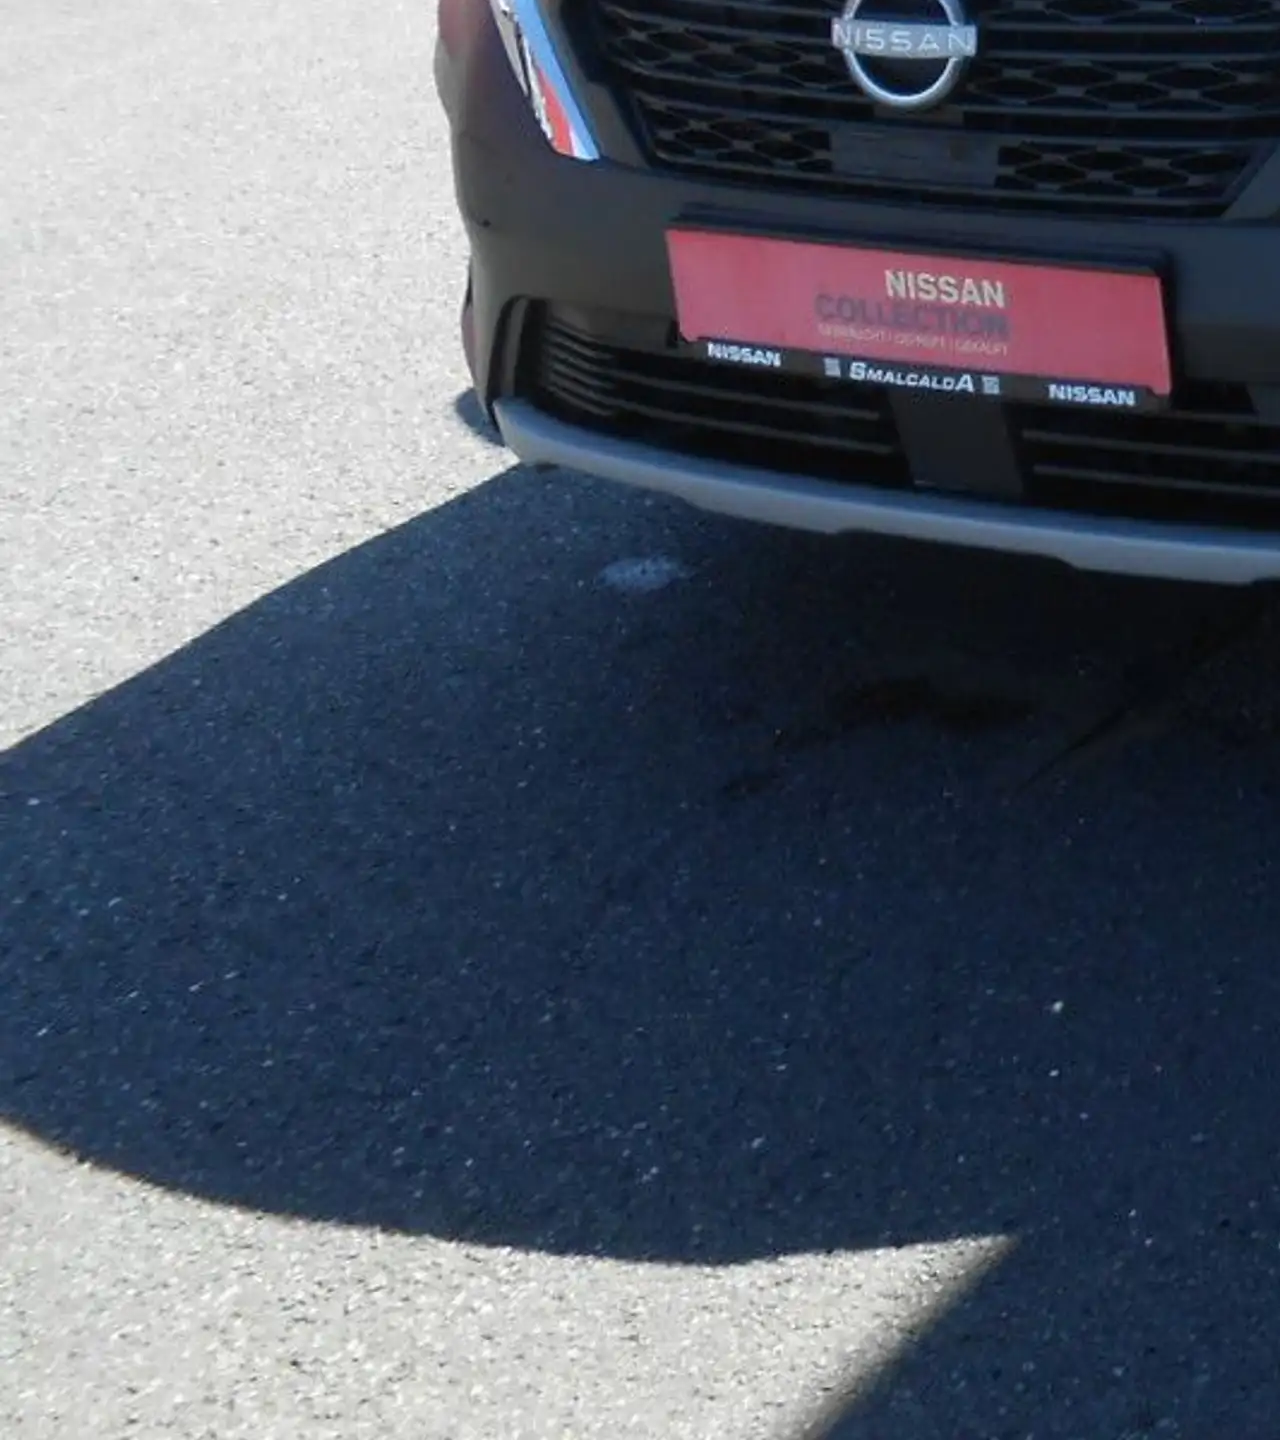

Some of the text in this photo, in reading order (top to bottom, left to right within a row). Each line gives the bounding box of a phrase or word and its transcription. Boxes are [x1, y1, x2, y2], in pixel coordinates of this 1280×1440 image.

[832, 22, 973, 54] NISSAN
[884, 269, 1006, 308] NISSAN
[815, 292, 1010, 340] COLLECTION
[707, 341, 781, 367] NISSAN
[1047, 383, 1136, 406] NISSAN
